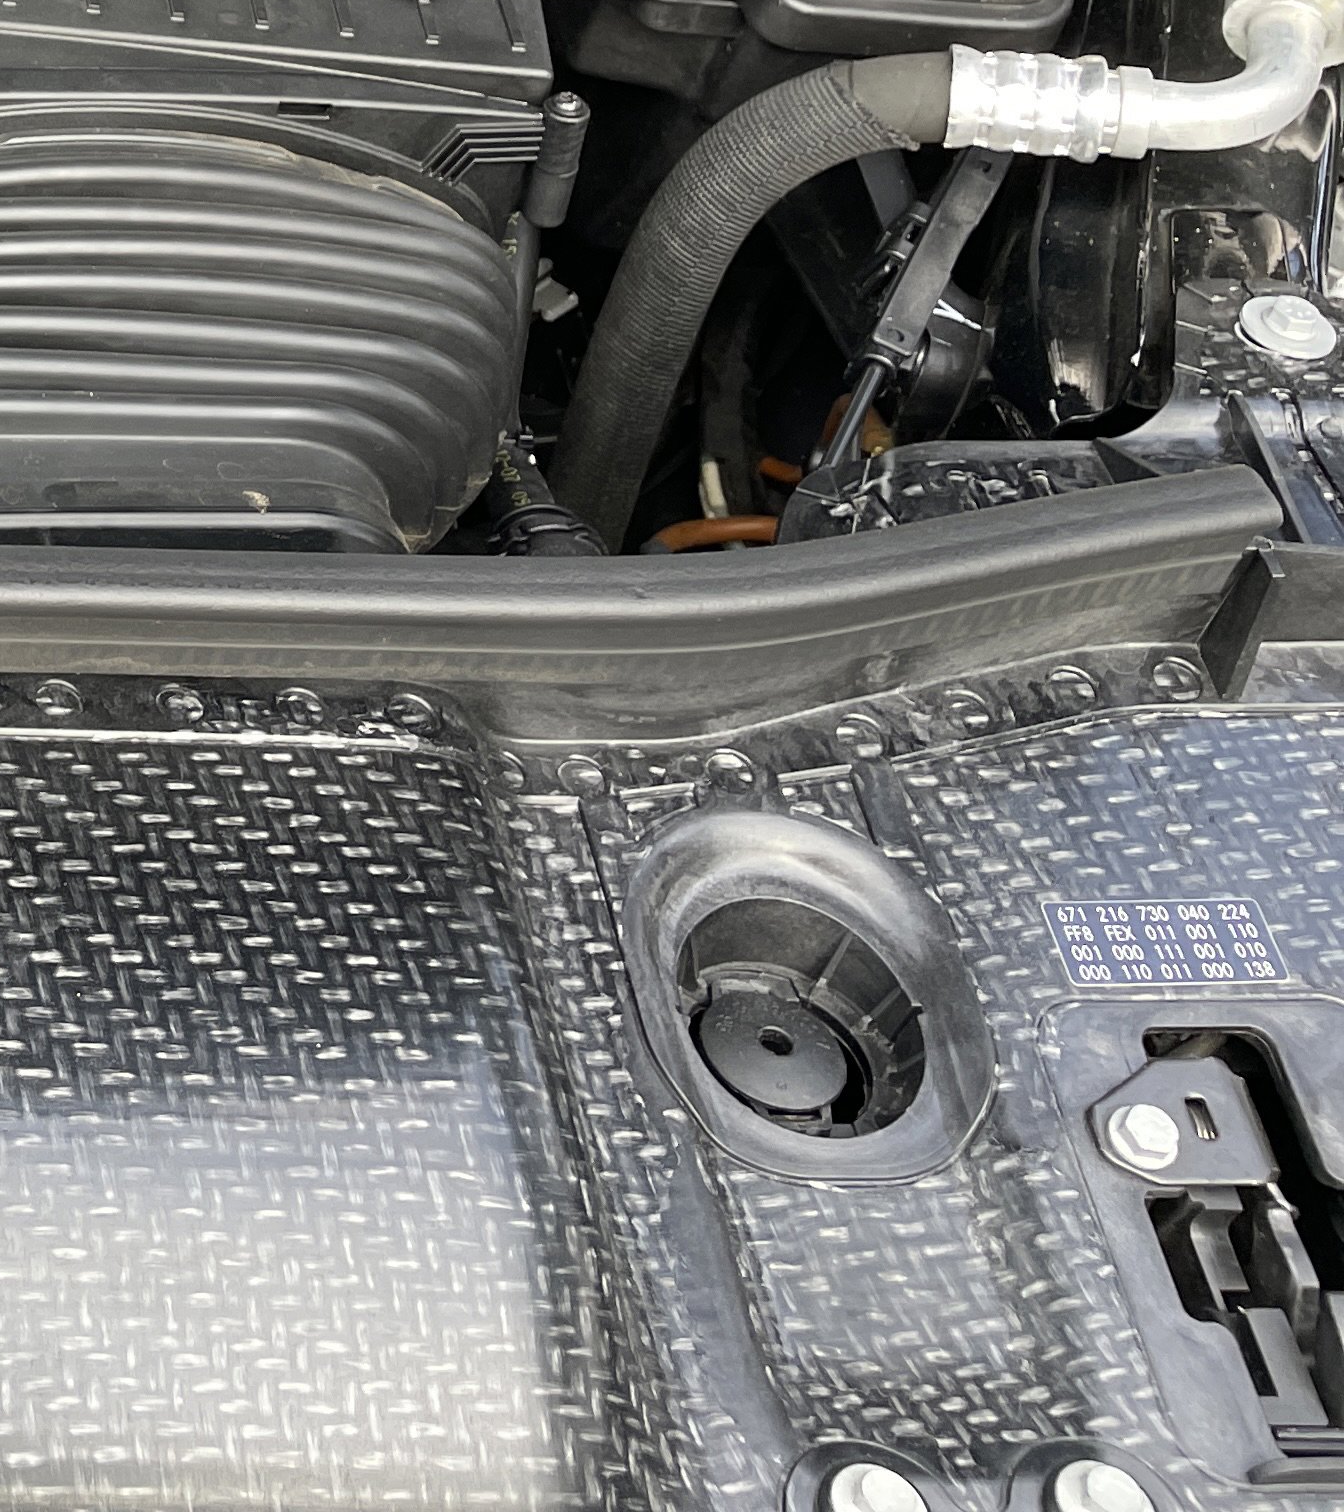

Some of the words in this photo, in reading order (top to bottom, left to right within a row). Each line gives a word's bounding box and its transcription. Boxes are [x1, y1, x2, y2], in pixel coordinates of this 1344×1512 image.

[1056, 906, 1088, 923] 671
[1095, 906, 1129, 922] 216
[1135, 905, 1170, 922] 730
[1177, 904, 1210, 921] 040
[1217, 904, 1250, 921] 224
[1063, 925, 1095, 942] FF8
[1103, 925, 1137, 941] FEX
[1144, 924, 1177, 941] 011
[1185, 924, 1217, 940] 001
[1227, 923, 1259, 939] 110
[1070, 944, 1103, 961] 001
[1111, 944, 1145, 961] 000
[1154, 943, 1186, 960] 111
[1193, 943, 1226, 959] 001
[1234, 942, 1267, 959] 010
[1078, 964, 1111, 981] 000
[1121, 964, 1153, 980] 110
[1160, 963, 1193, 980] 011
[1201, 962, 1235, 979] 000
[1243, 961, 1276, 978] 138
